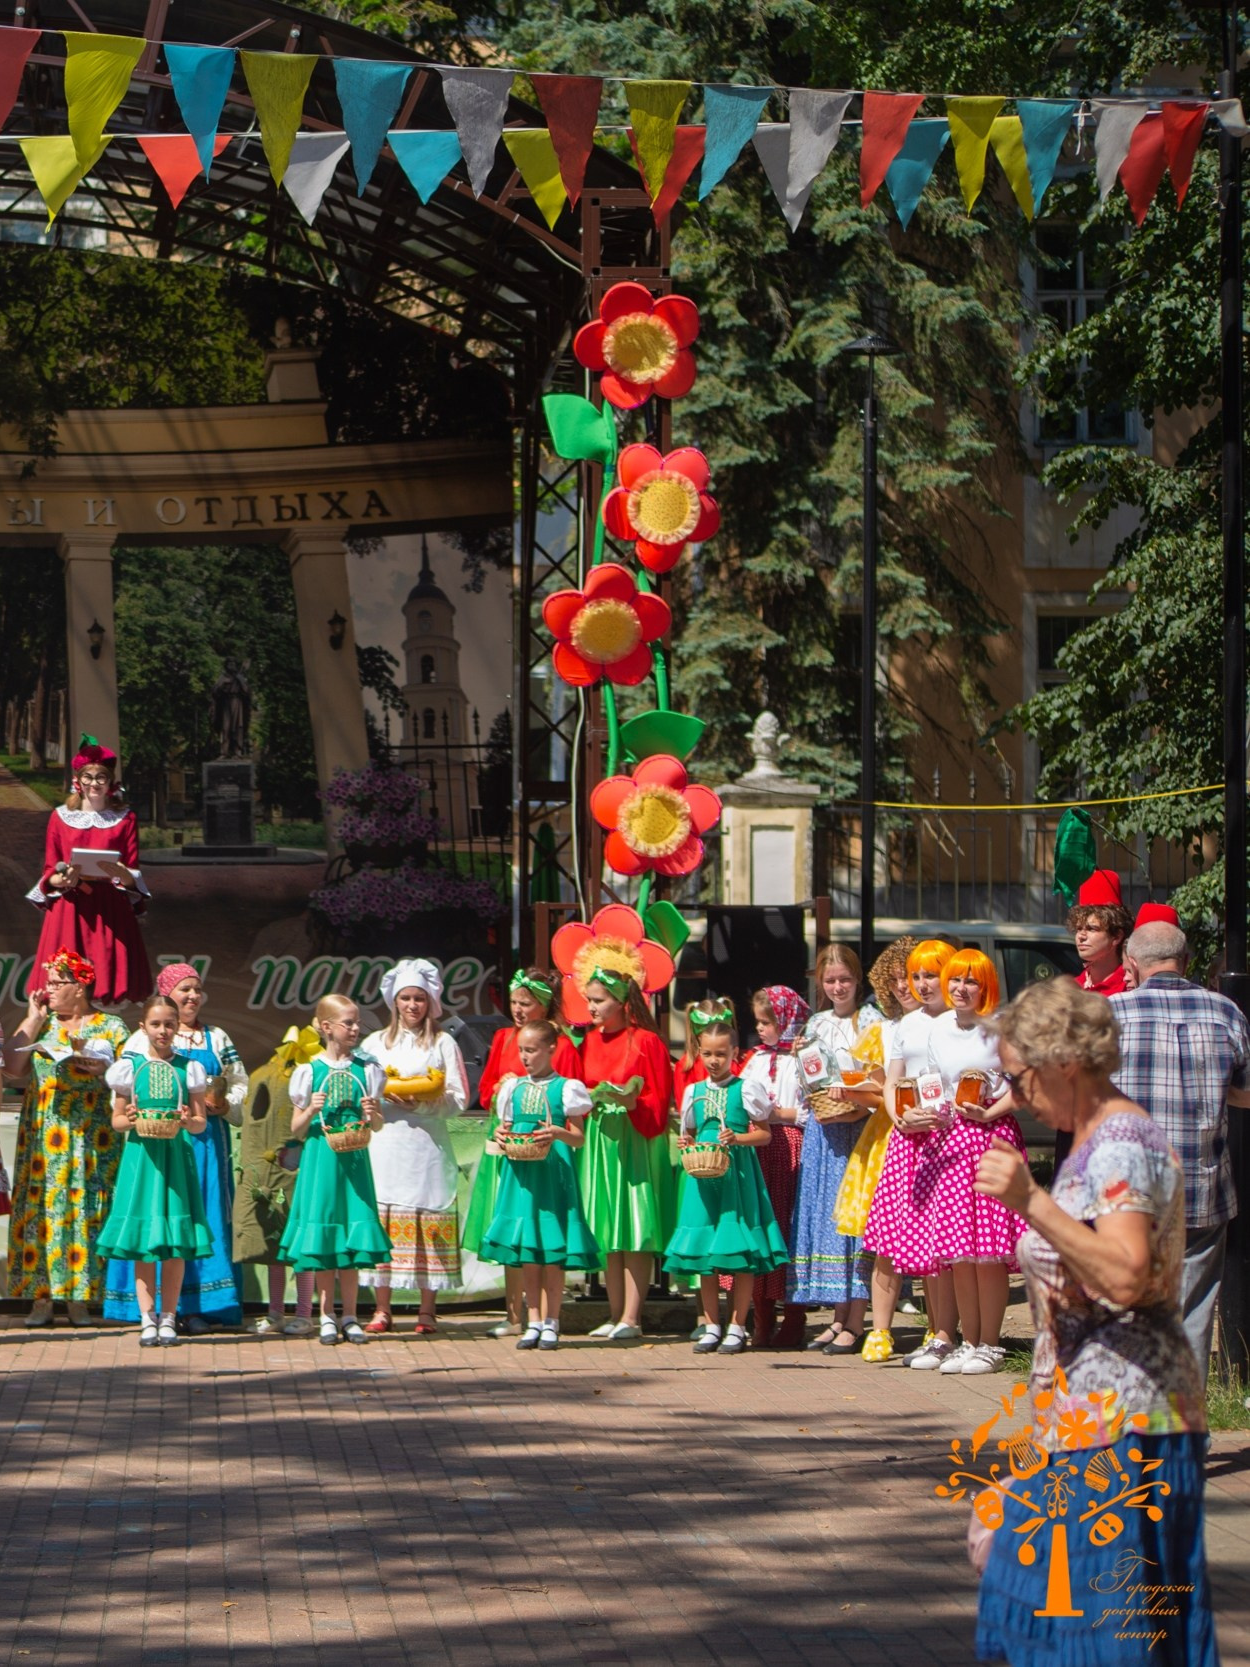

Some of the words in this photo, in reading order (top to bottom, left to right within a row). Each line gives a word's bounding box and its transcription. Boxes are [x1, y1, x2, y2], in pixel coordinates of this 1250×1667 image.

[83, 498, 118, 527] И
[155, 489, 392, 528] ОТДЫХА
[248, 954, 485, 1013] паре
